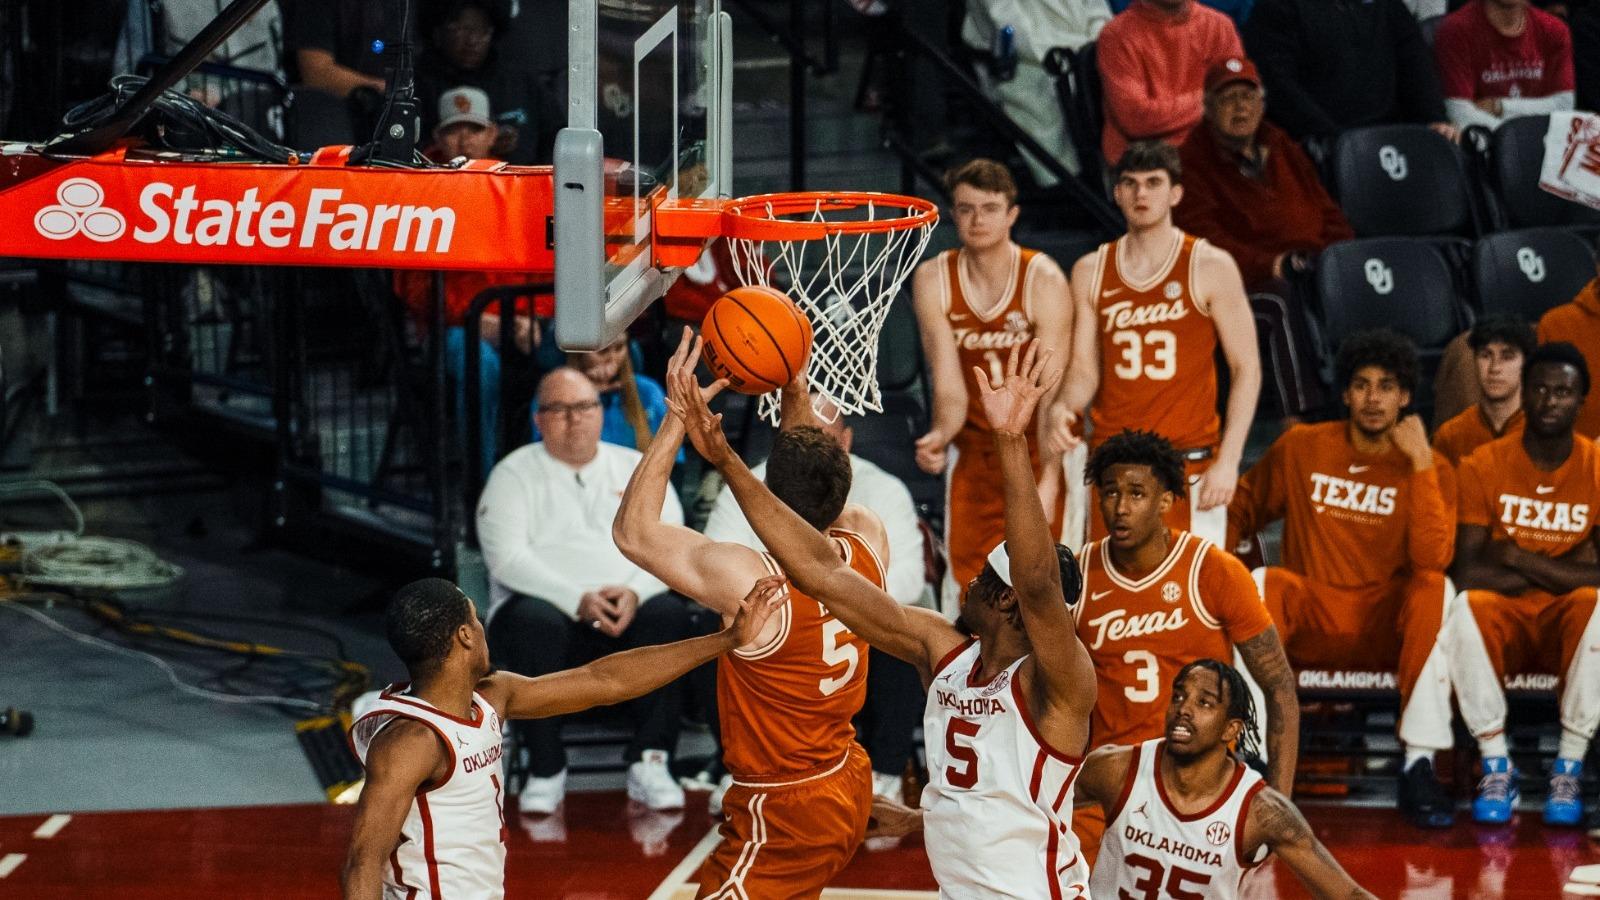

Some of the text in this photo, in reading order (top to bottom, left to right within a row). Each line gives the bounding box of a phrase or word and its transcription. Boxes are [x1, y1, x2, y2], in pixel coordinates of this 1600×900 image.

[1379, 145, 1408, 180] OU
[1364, 258, 1394, 294] OU
[1517, 247, 1545, 282] OU
[1101, 299, 1190, 333] Texas
[1112, 329, 1177, 381] 33
[1310, 472, 1398, 515] TEXAS
[1499, 493, 1590, 532] TEXAS
[1088, 607, 1190, 651] Texas
[818, 618, 859, 697] 5
[1122, 649, 1159, 703] 3
[1298, 669, 1397, 690] OKLAHOMA
[936, 689, 1006, 716] OKLHOMA
[945, 716, 982, 790] 5
[1124, 825, 1224, 868] OKLAHOMA
[1206, 821, 1231, 847] SEC
